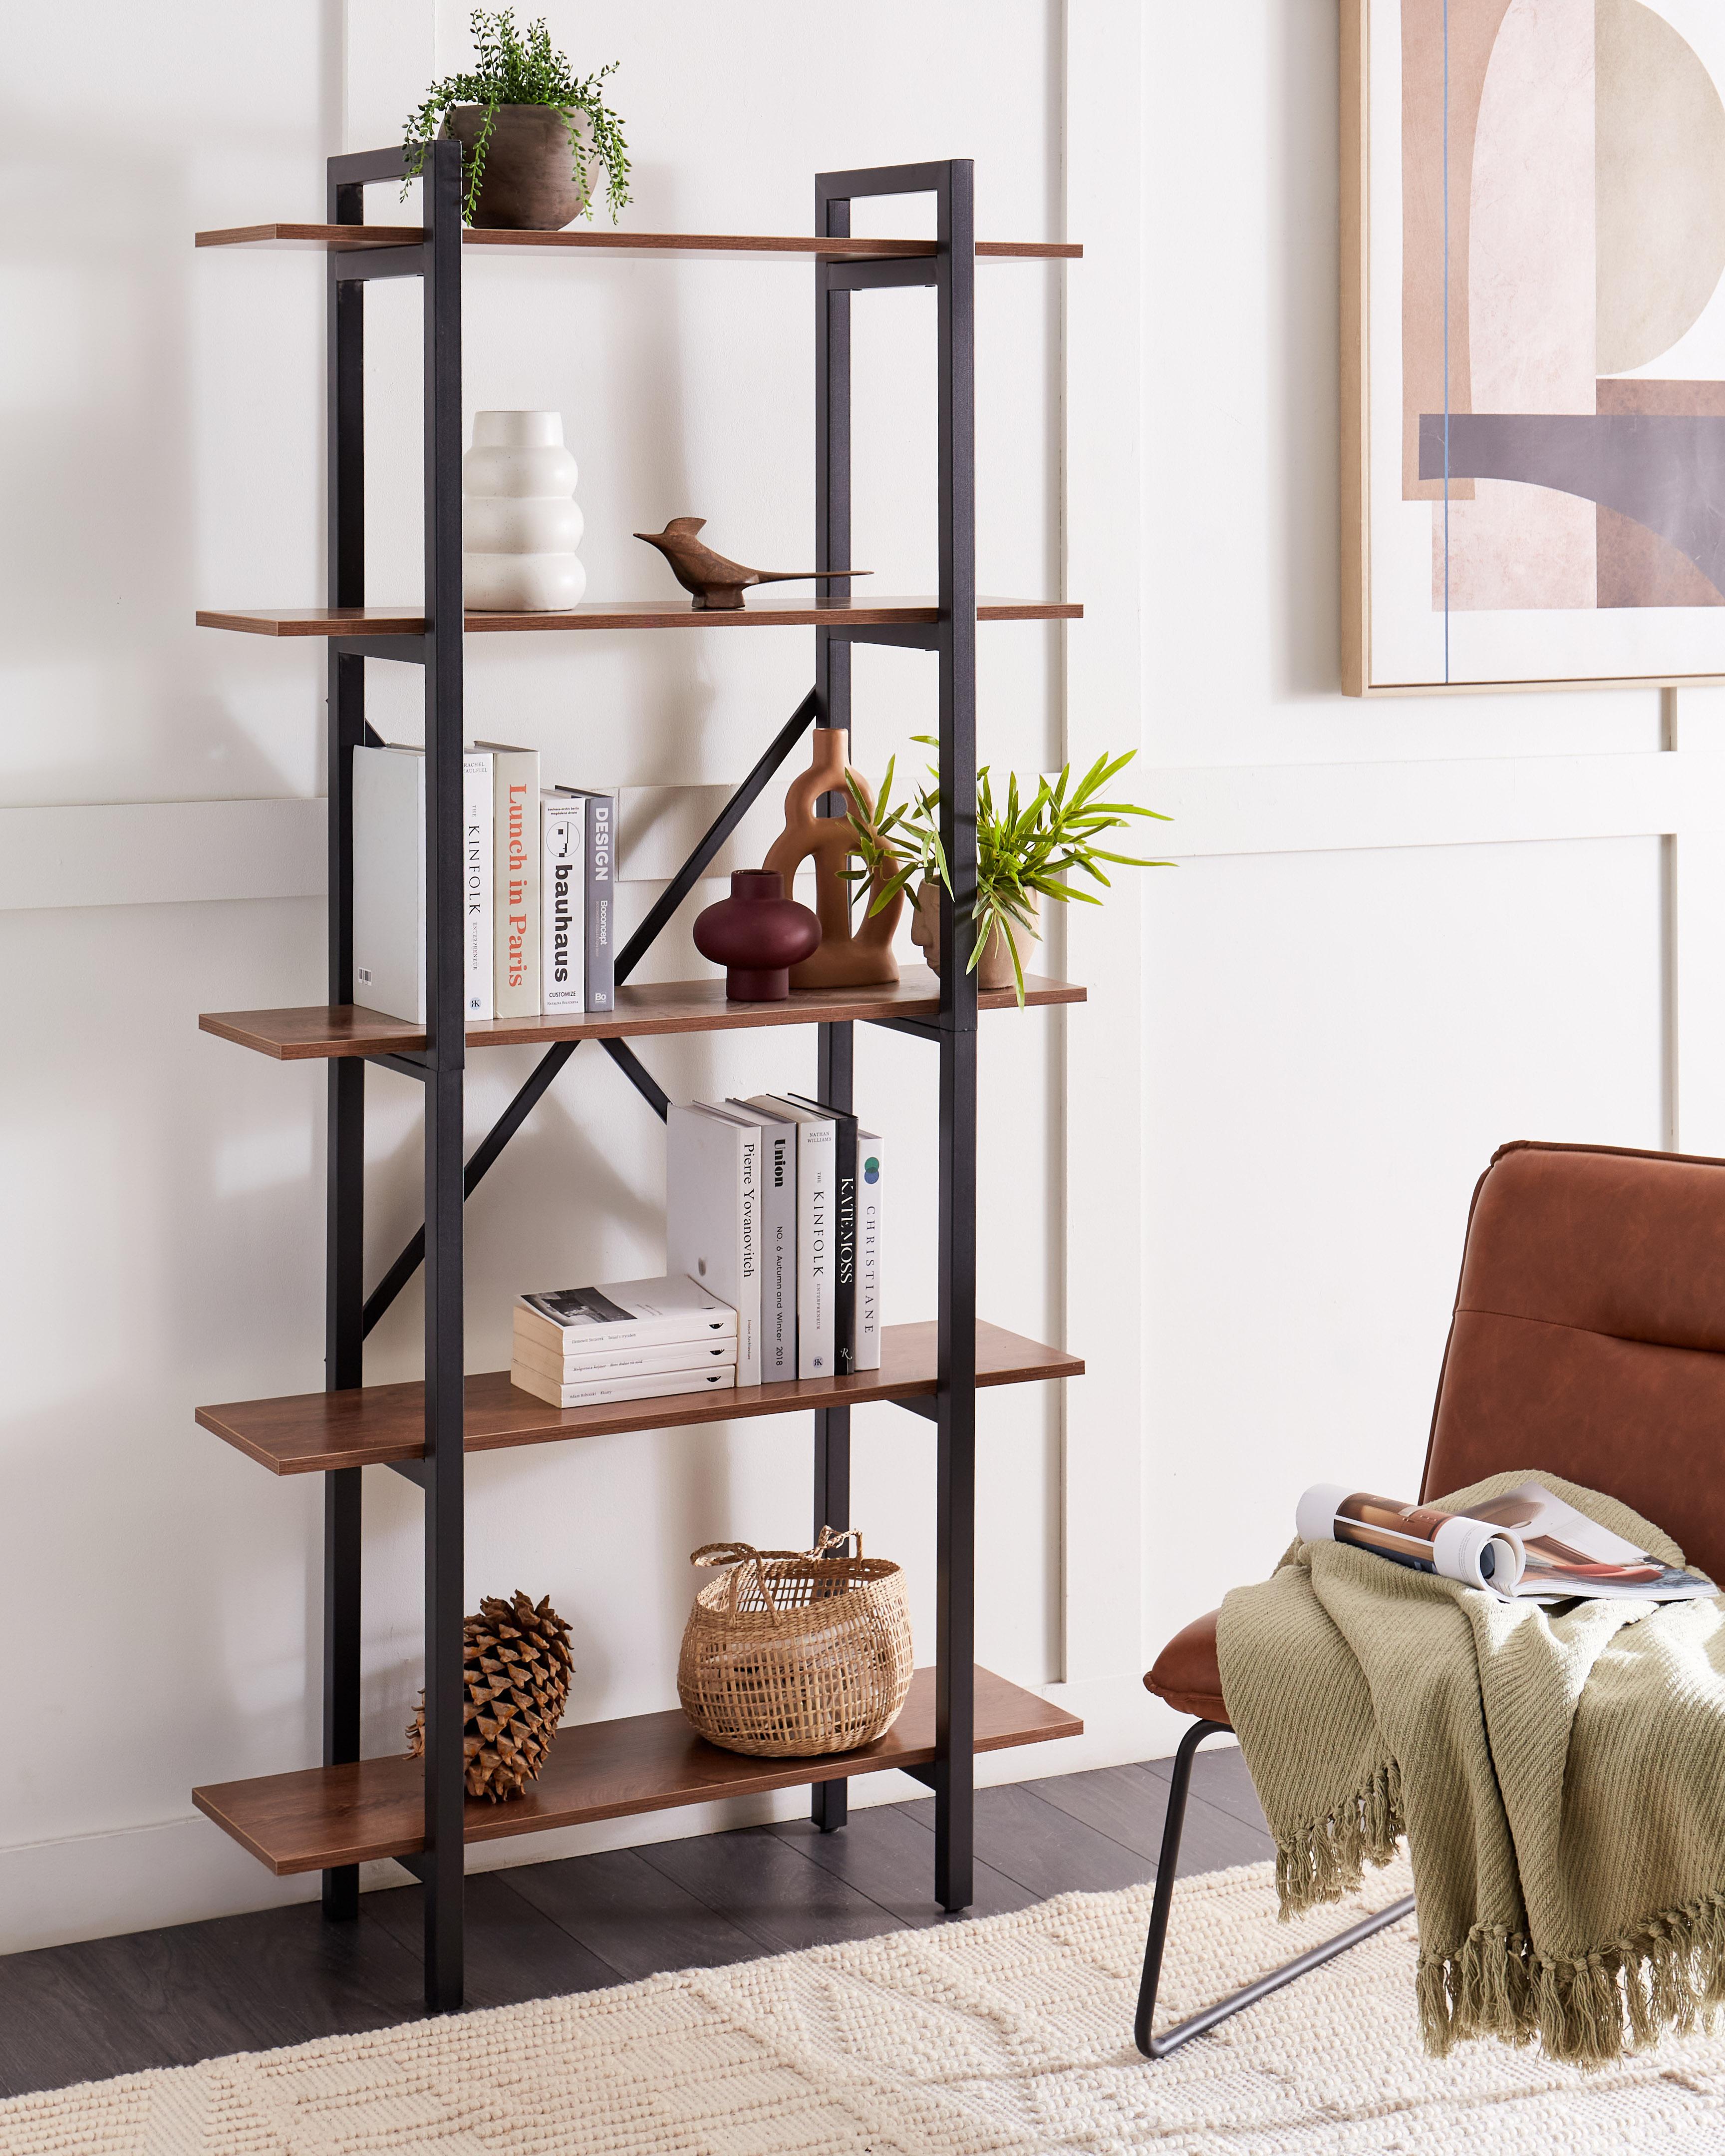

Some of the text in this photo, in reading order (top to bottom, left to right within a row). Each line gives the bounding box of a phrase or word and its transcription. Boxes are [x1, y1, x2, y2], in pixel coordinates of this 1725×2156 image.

[469, 825, 480, 915] KINFOLK
[509, 784, 527, 987] Lunch in Paris
[595, 808, 609, 880] DESIGN
[555, 864, 573, 982] bauhaus
[744, 1143, 755, 1277] Pierre Yovanovitch
[774, 1138, 786, 1187] Union
[813, 1191, 824, 1277] KINFOLK
[841, 1178, 854, 1284] KATE MOSS
[864, 1206, 875, 1333] CHRISTIANE
